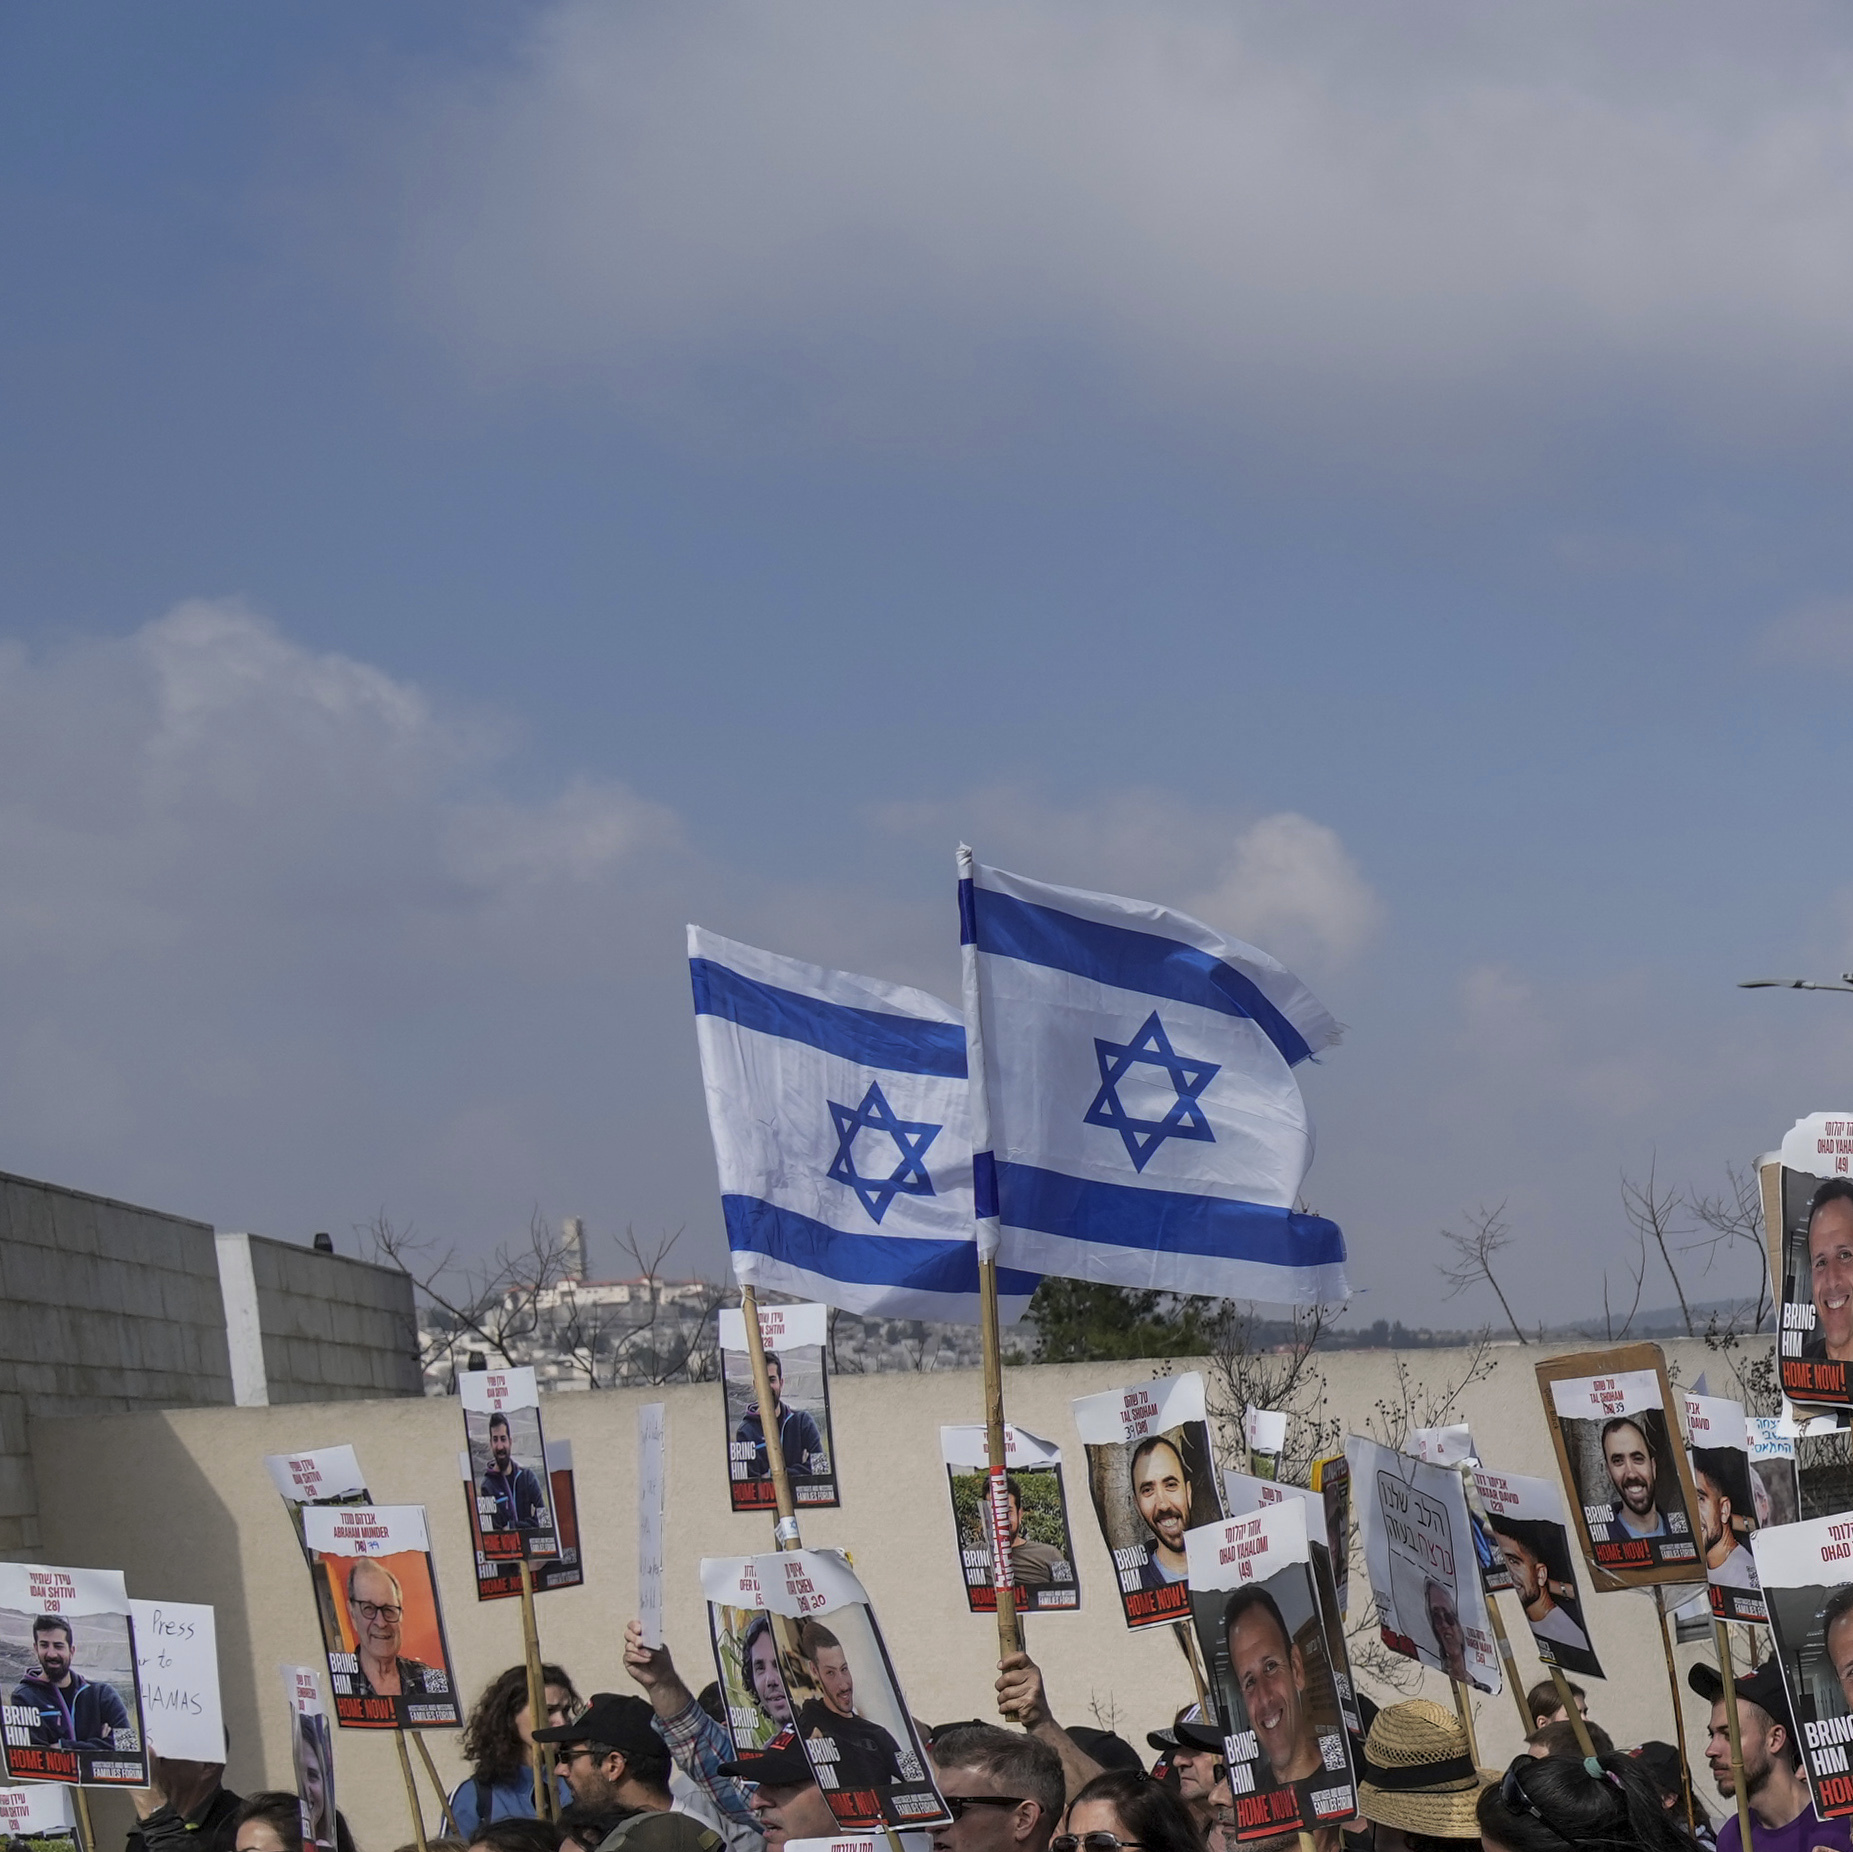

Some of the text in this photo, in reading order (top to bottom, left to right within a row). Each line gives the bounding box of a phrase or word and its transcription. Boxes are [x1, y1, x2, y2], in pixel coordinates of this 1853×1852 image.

[1590, 1390, 1624, 1403] TAL SHOHAM
[1120, 1404, 1159, 1423] TAL SHOHAM
[1691, 1417, 1710, 1431] DAVID
[334, 1527, 389, 1538] ABRAHAM MUNDER
[1590, 1524, 1610, 1542] HIM
[1219, 1545, 1236, 1565] OHAD
[48, 1587, 76, 1598] SHTIVI
[44, 1600, 60, 1612] (28)
[153, 1610, 194, 1640] Press
[158, 1649, 173, 1668] to
